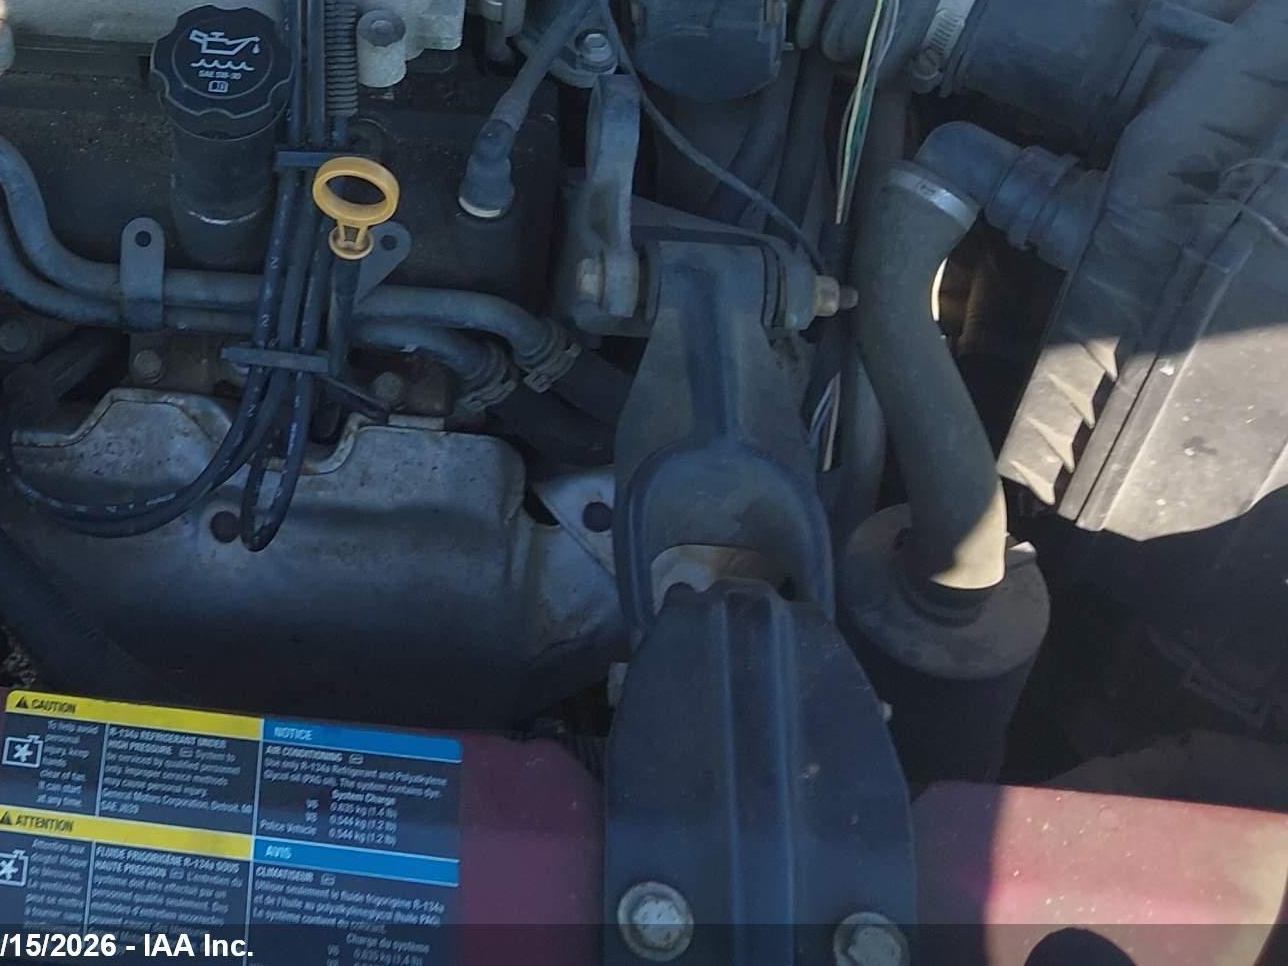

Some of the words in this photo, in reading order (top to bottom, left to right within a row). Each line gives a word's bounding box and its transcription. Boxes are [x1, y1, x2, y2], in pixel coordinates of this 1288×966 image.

[30, 699, 76, 713] CAUTION
[273, 726, 312, 741] NOTICE
[15, 815, 74, 832] ATTENTION
[264, 844, 292, 860] AVIS
